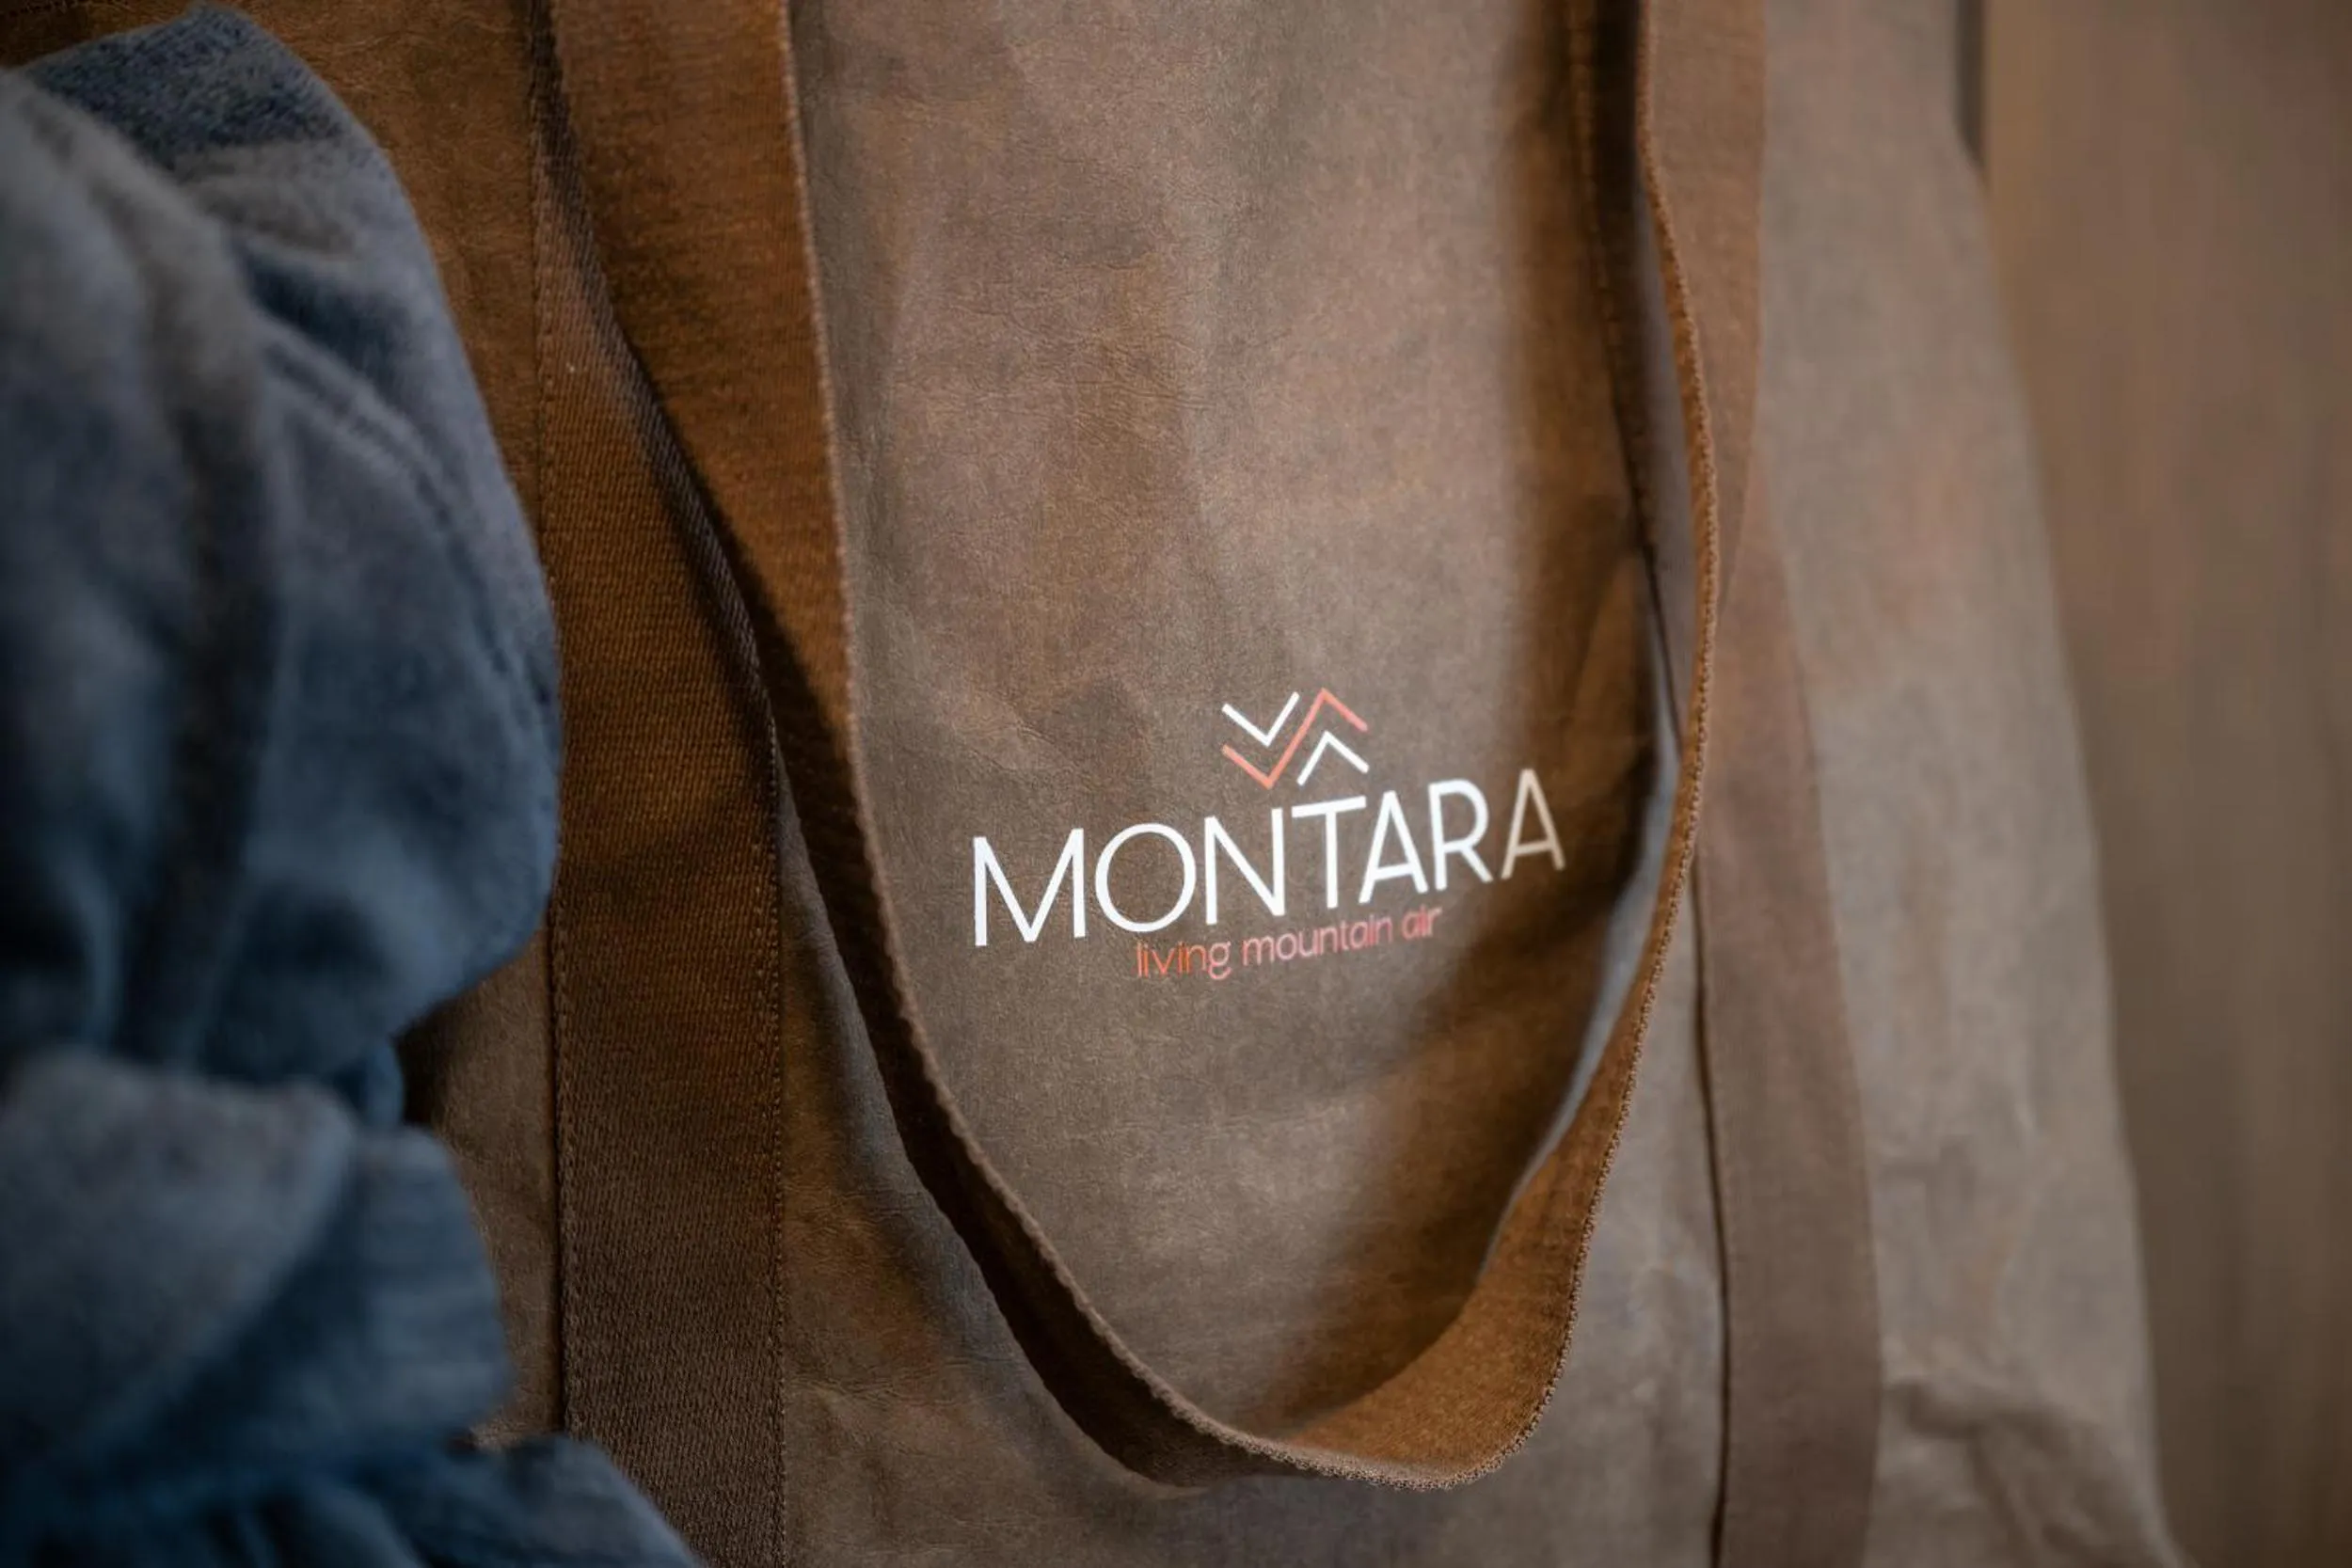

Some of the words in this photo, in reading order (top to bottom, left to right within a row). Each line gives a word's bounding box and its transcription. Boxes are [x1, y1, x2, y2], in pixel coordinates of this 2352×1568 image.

[973, 768, 1565, 946] MONTARA
[1136, 940, 1232, 980] living
[1242, 913, 1394, 967] mountain
[1402, 903, 1442, 940] air
